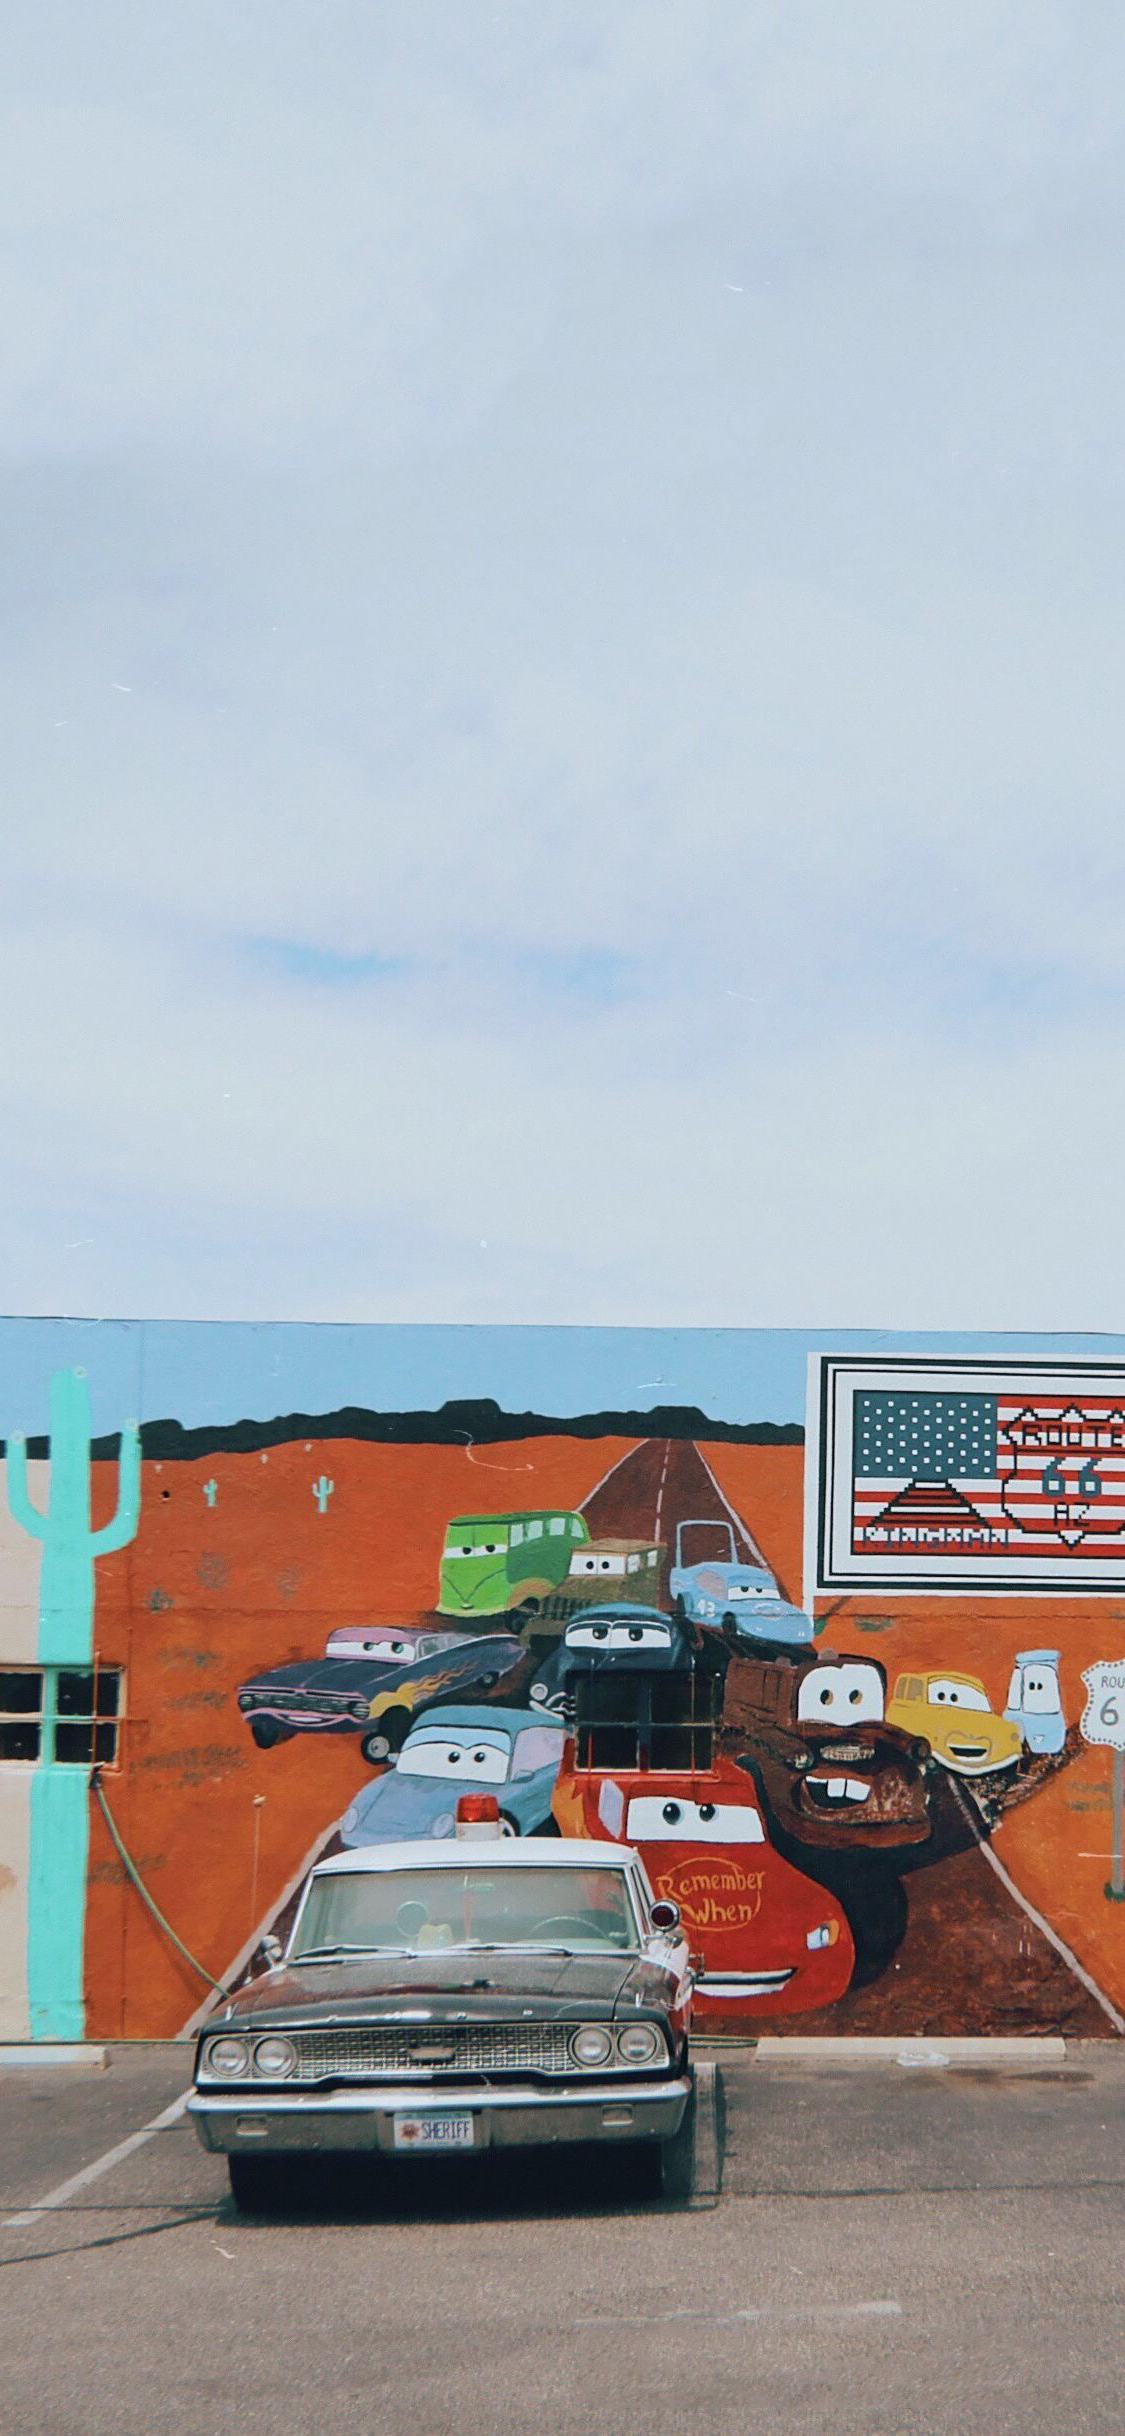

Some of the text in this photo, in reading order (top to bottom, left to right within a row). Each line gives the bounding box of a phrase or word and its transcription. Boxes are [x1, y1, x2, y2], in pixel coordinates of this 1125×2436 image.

[1022, 1424, 1123, 1448] ROUTE
[1042, 1457, 1102, 1498] 66
[1053, 1502, 1090, 1527] AZ
[863, 1526, 1009, 1549] KINGMAN
[656, 1868, 766, 1902] Remember
[680, 1898, 752, 1924] When
[421, 2120, 470, 2140] SHERIFF
